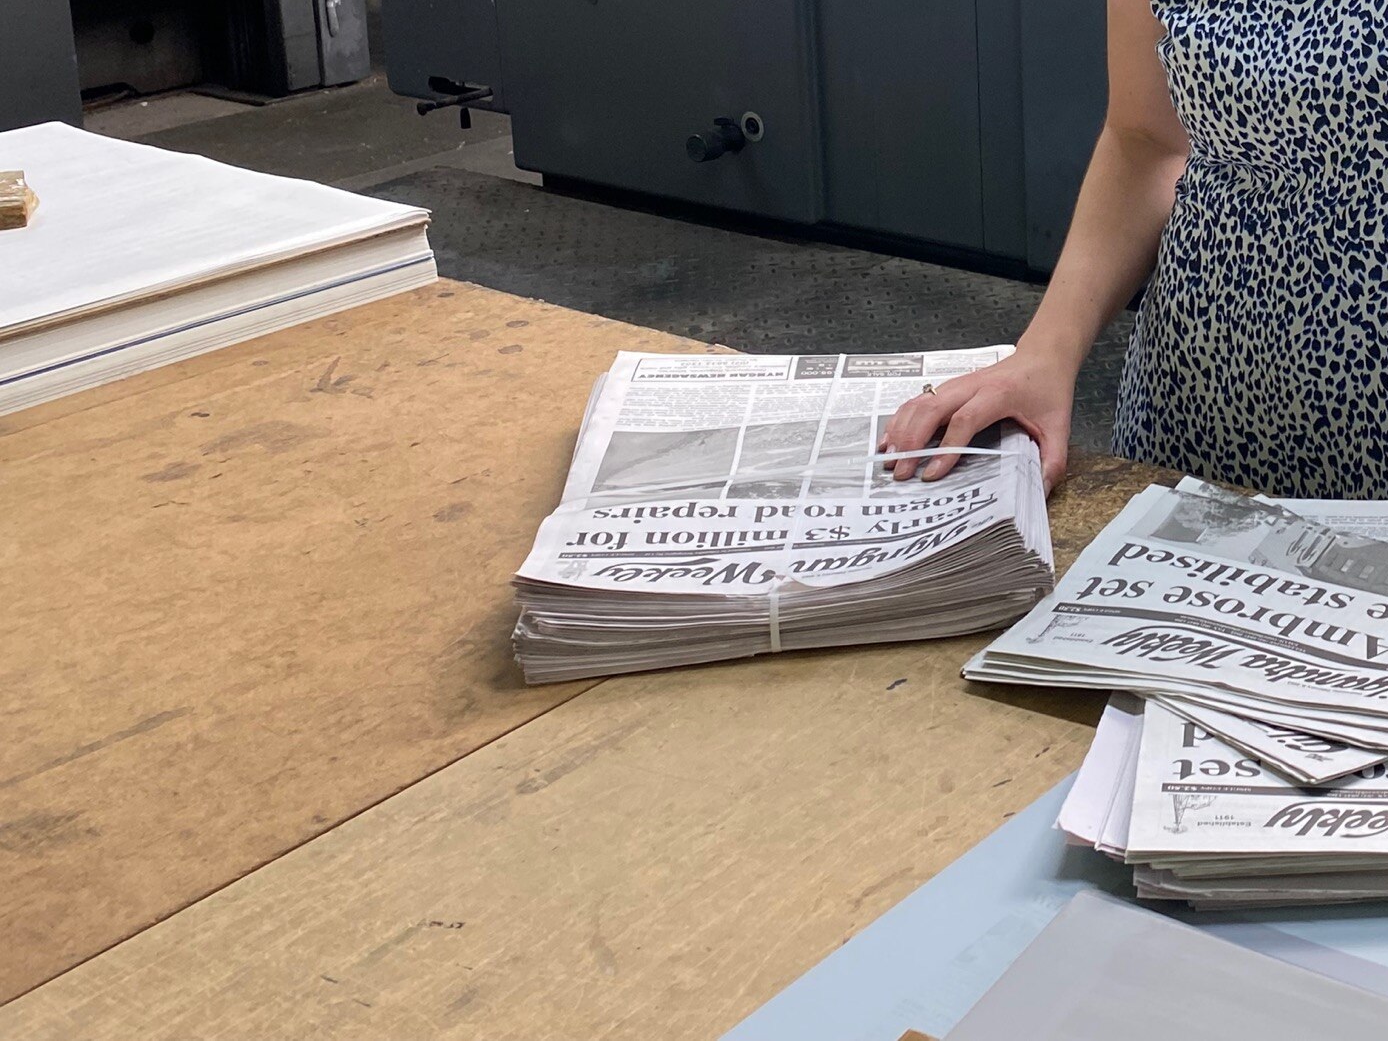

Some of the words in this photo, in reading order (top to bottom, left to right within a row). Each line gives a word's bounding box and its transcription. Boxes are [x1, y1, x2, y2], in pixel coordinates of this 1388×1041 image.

[592, 501, 738, 524] repairs
[861, 486, 982, 517] Bogan
[753, 504, 846, 524] road
[565, 530, 630, 550] for
[644, 528, 790, 549] million
[804, 525, 850, 542] $3
[788, 519, 970, 574] Nyngan
[588, 557, 776, 586] Weekly
[1106, 542, 1356, 610] stabilised
[1076, 576, 1154, 601] set
[1100, 630, 1244, 670] Weekly
[1171, 758, 1261, 782] set
